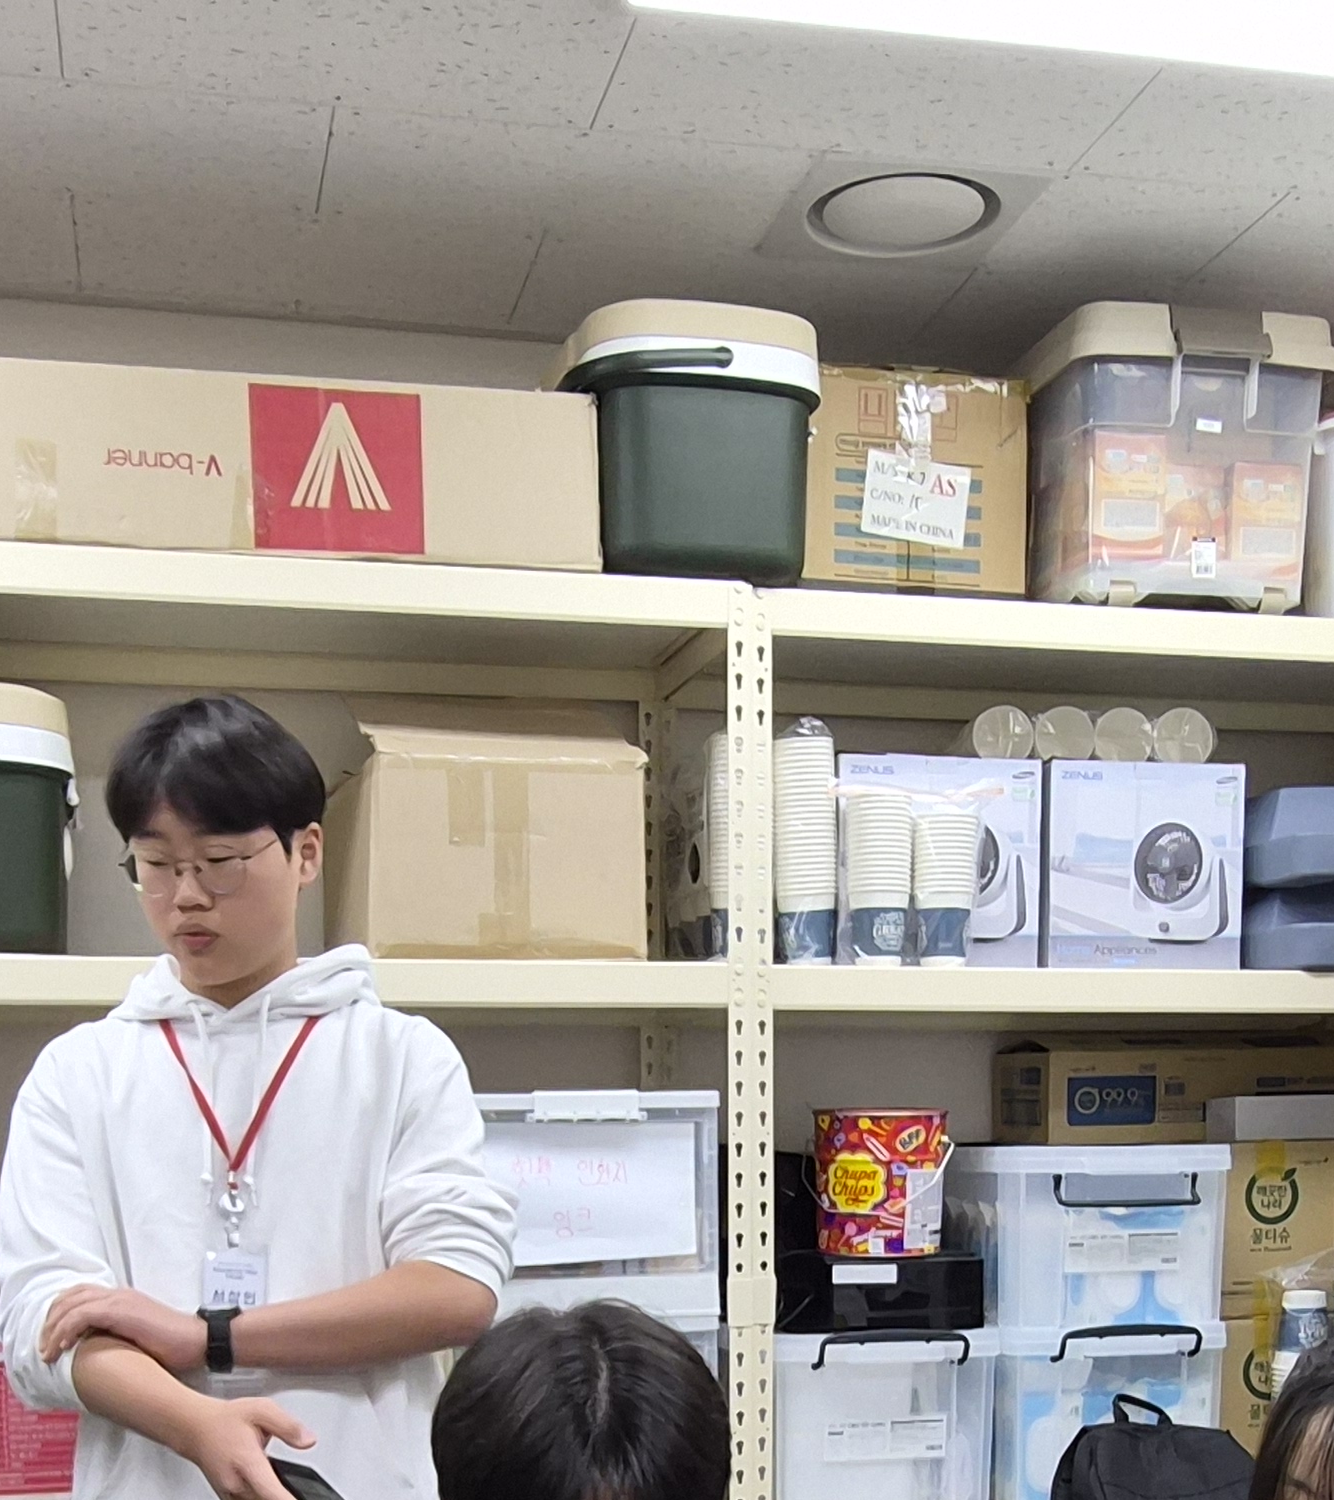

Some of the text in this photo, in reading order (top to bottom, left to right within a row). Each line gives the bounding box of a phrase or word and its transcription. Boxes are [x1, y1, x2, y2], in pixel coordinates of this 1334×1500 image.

[104, 447, 225, 481] V-banner
[929, 473, 958, 498] AS
[850, 764, 895, 776] ZENUS
[1061, 770, 1103, 781] ZENUS
[833, 1165, 880, 1181] Chupa
[832, 1181, 876, 1197] Chups
